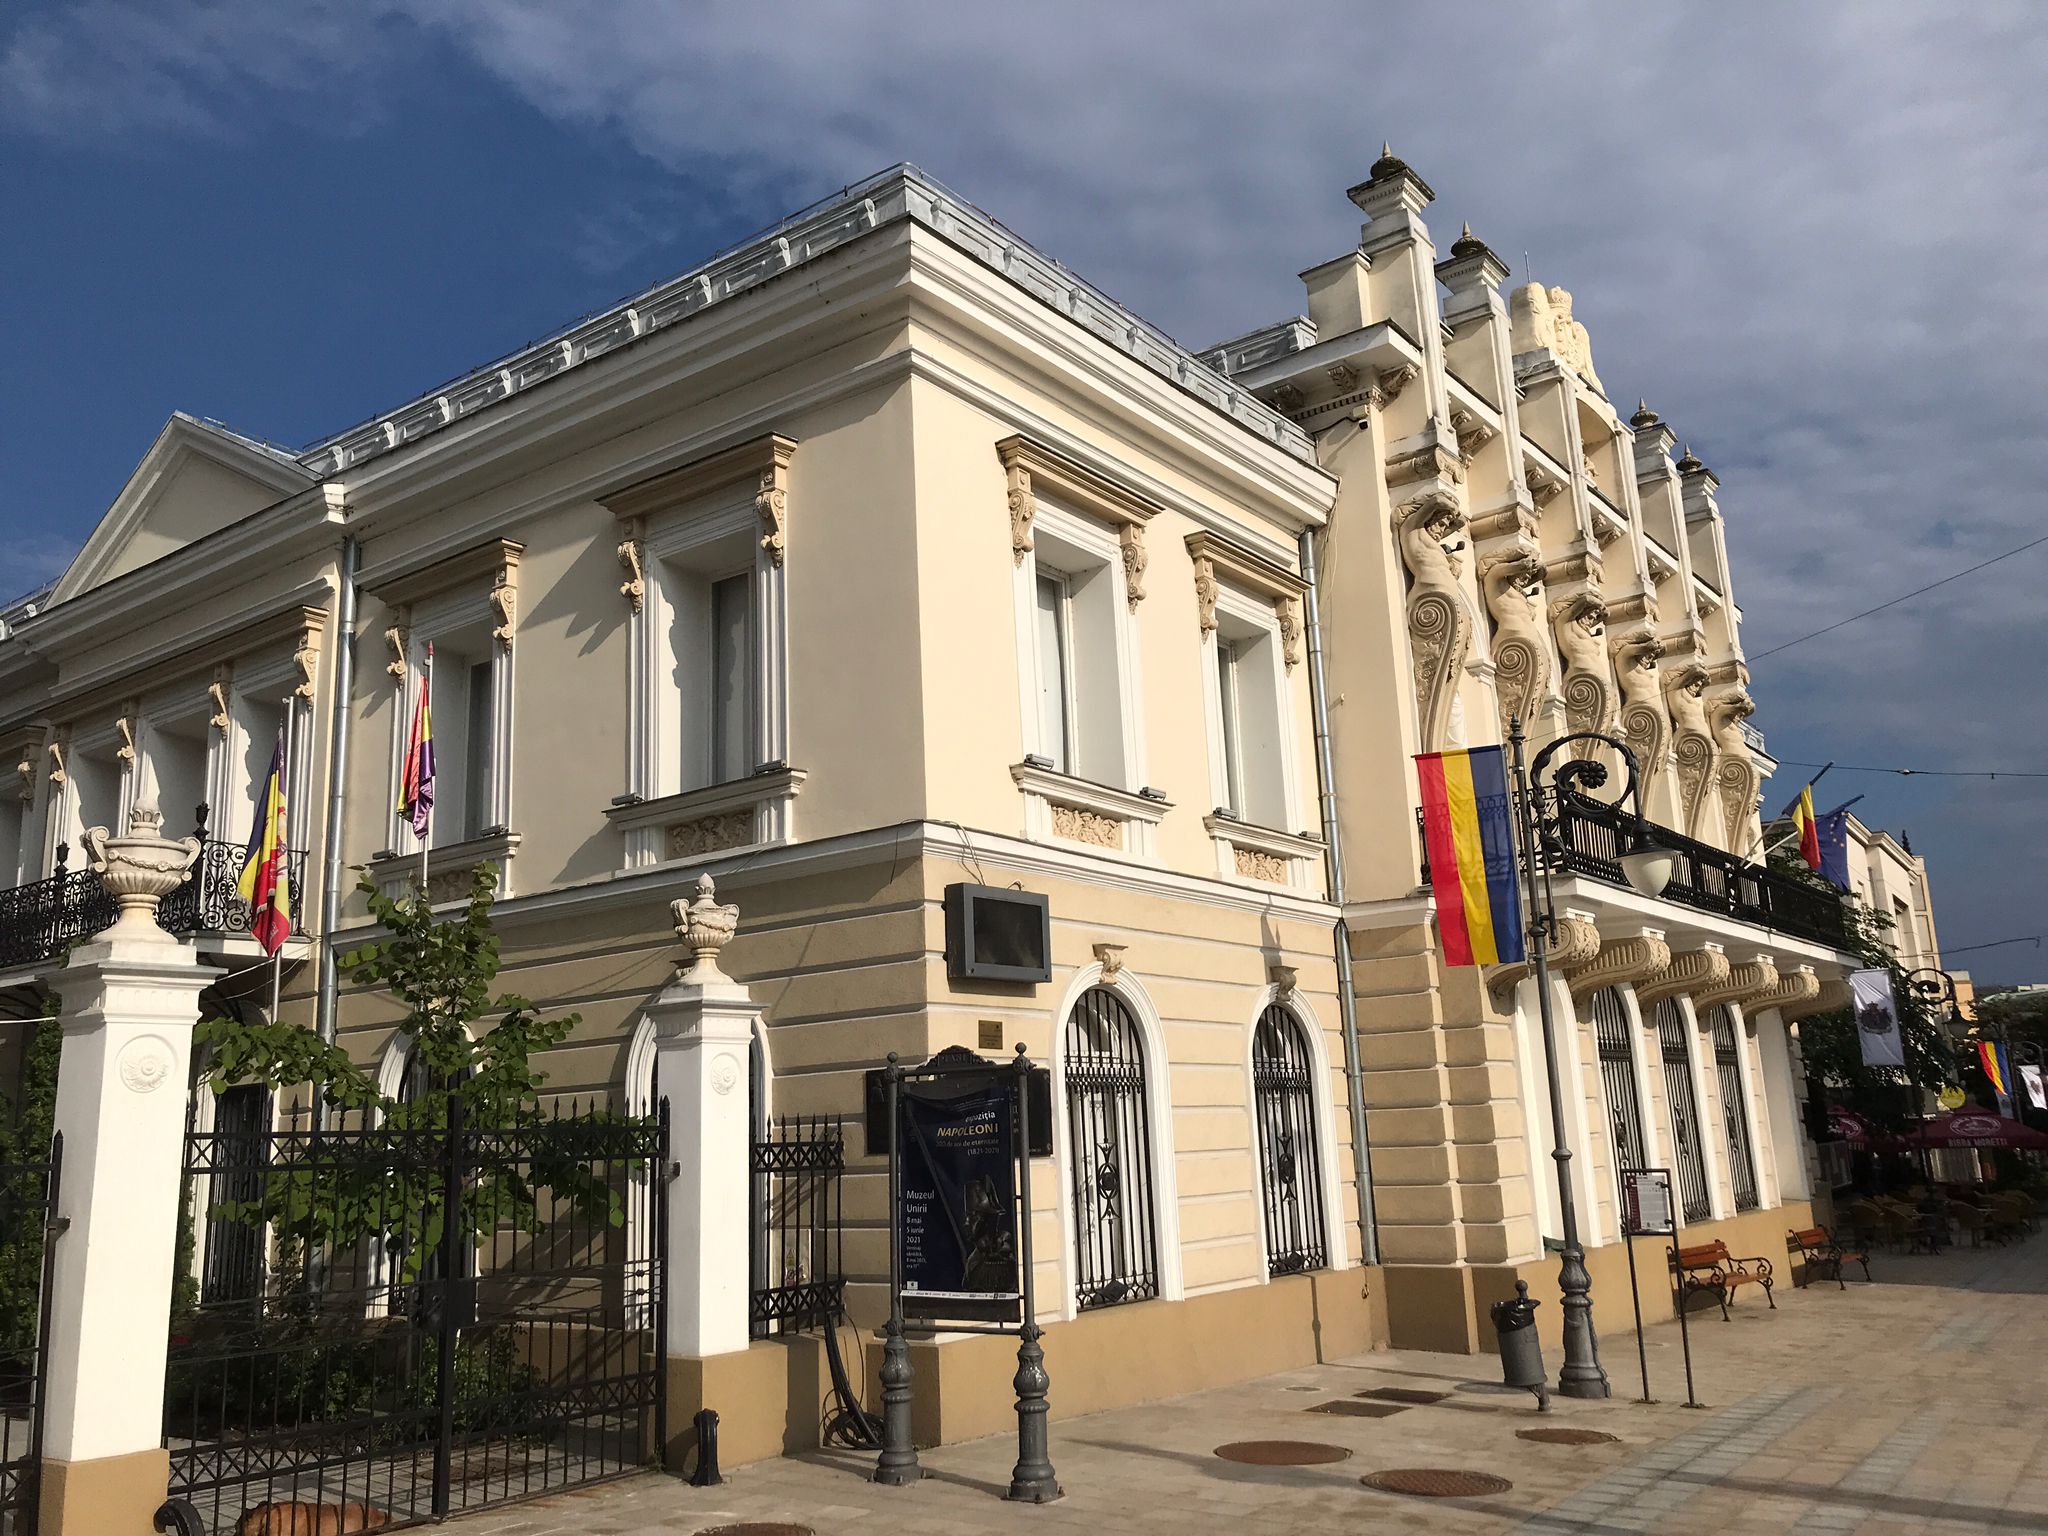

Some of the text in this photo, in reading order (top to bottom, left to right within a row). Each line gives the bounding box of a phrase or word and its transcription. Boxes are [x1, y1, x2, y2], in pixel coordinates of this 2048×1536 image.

[937, 1123, 994, 1137] NAPOLEON
[963, 1139, 970, 1147] de
[1947, 1137, 2008, 1147] BIRRA MORETTI
[906, 1189, 935, 1200] Muzeul
[906, 1203, 928, 1213] Unirii
[906, 1216, 922, 1224] 8 mai
[906, 1226, 925, 1234] 5 iunie
